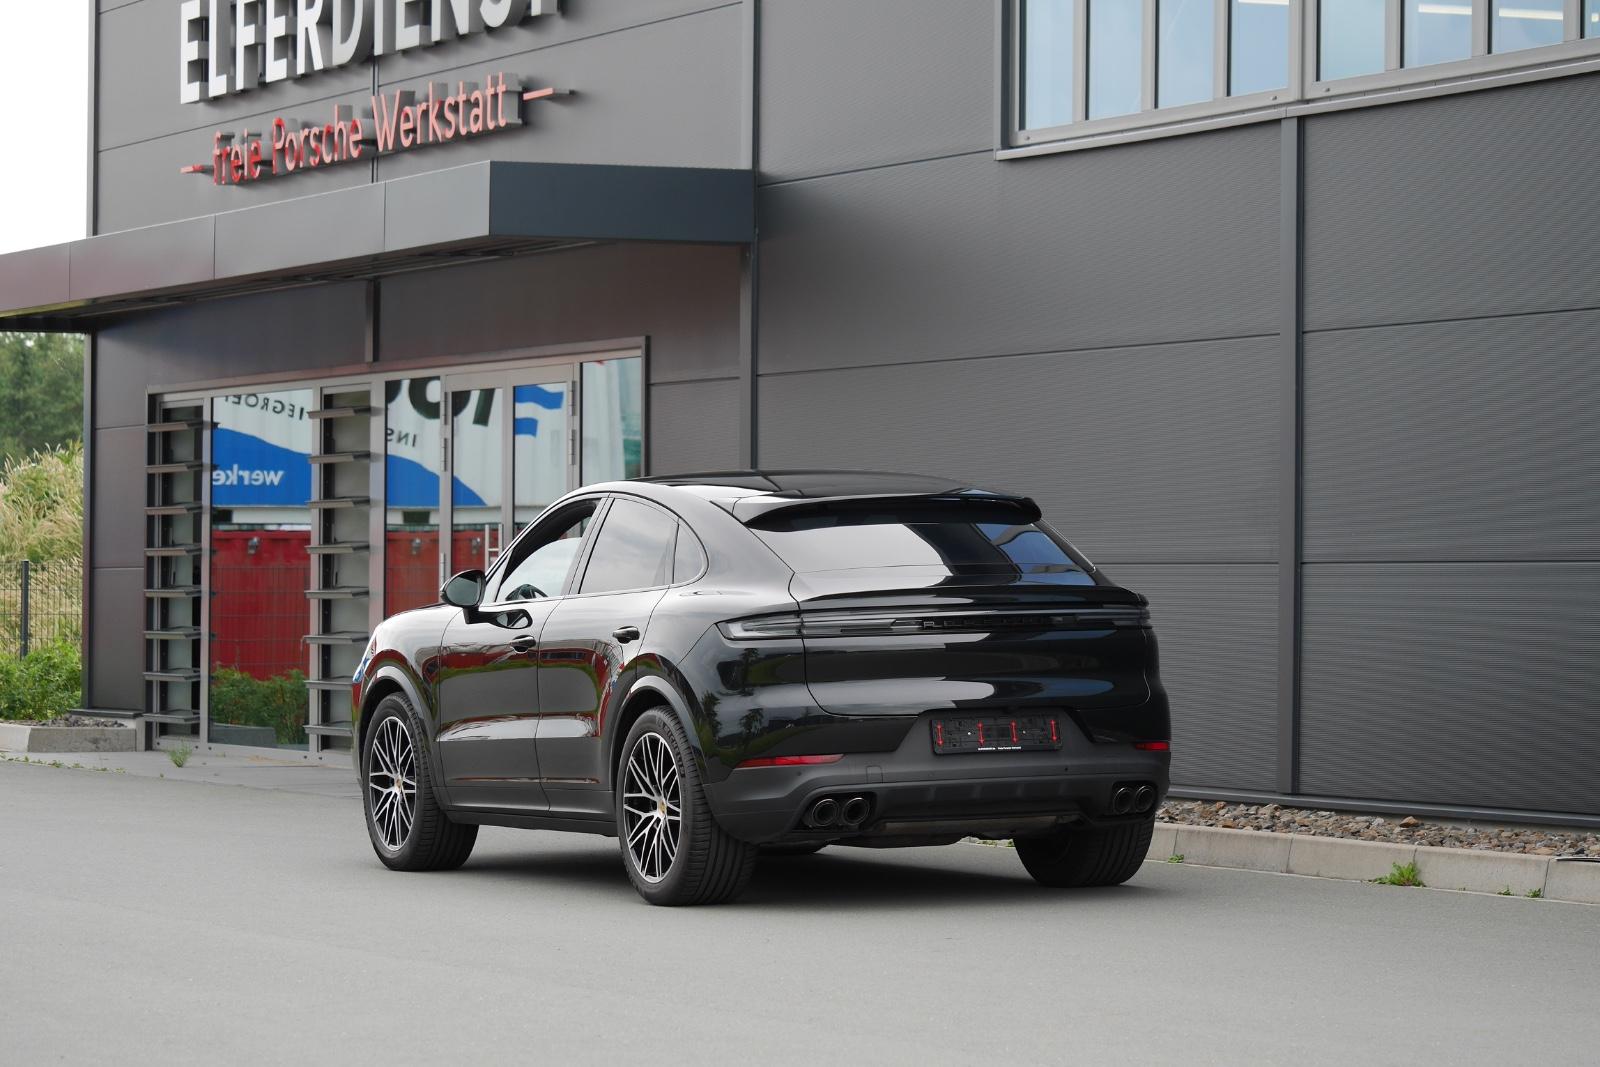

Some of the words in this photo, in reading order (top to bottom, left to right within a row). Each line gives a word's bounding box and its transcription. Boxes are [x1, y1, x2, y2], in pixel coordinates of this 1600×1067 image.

[180, 0, 542, 105] ELFERDI
[213, 128, 262, 185] freie
[272, 104, 363, 174] Porsche
[371, 71, 507, 153] Werkstatt
